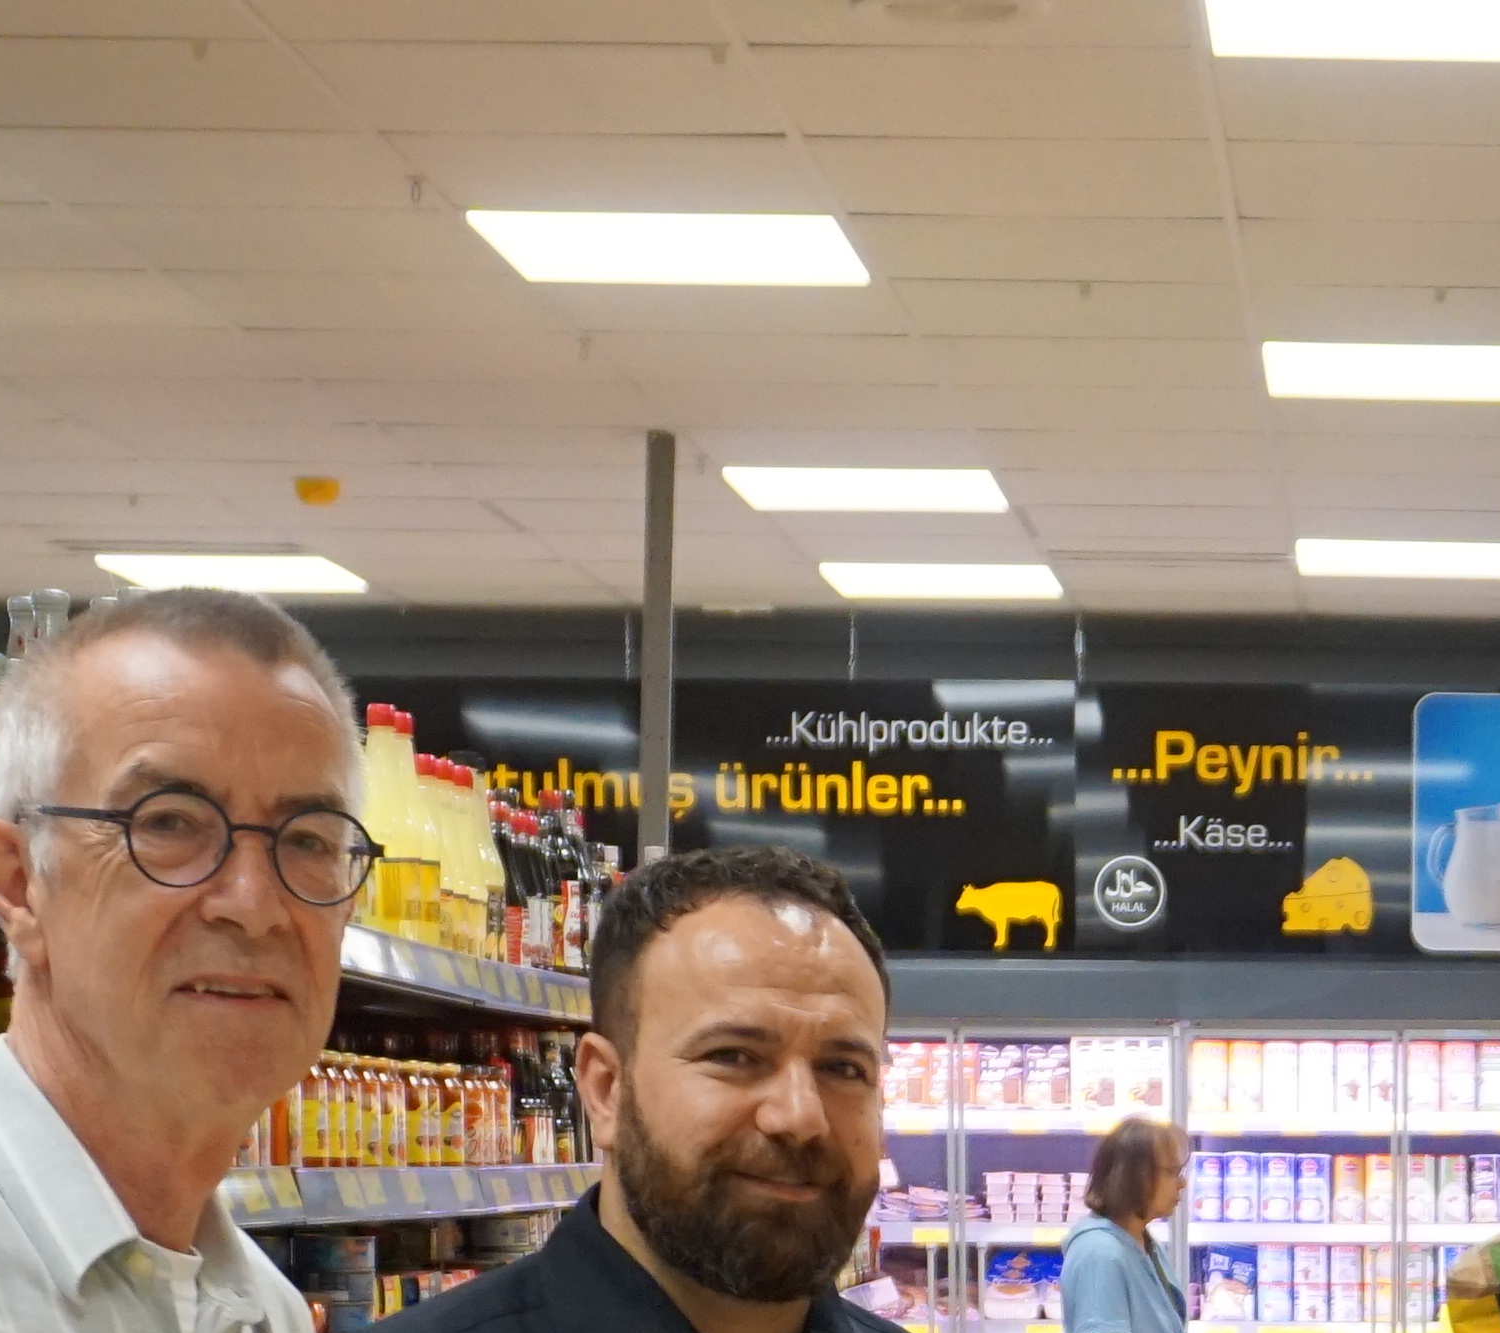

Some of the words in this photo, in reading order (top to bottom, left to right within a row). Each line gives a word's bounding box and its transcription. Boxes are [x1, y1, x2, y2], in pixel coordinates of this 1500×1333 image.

[765, 711, 1053, 752] ...Kühlprodukte...
[1111, 730, 1373, 796] ...Peynir...
[715, 762, 964, 815] ürünler...
[1153, 815, 1293, 849] ...Käse...
[1105, 868, 1154, 898] حلال
[1111, 901, 1147, 913] HALAL
